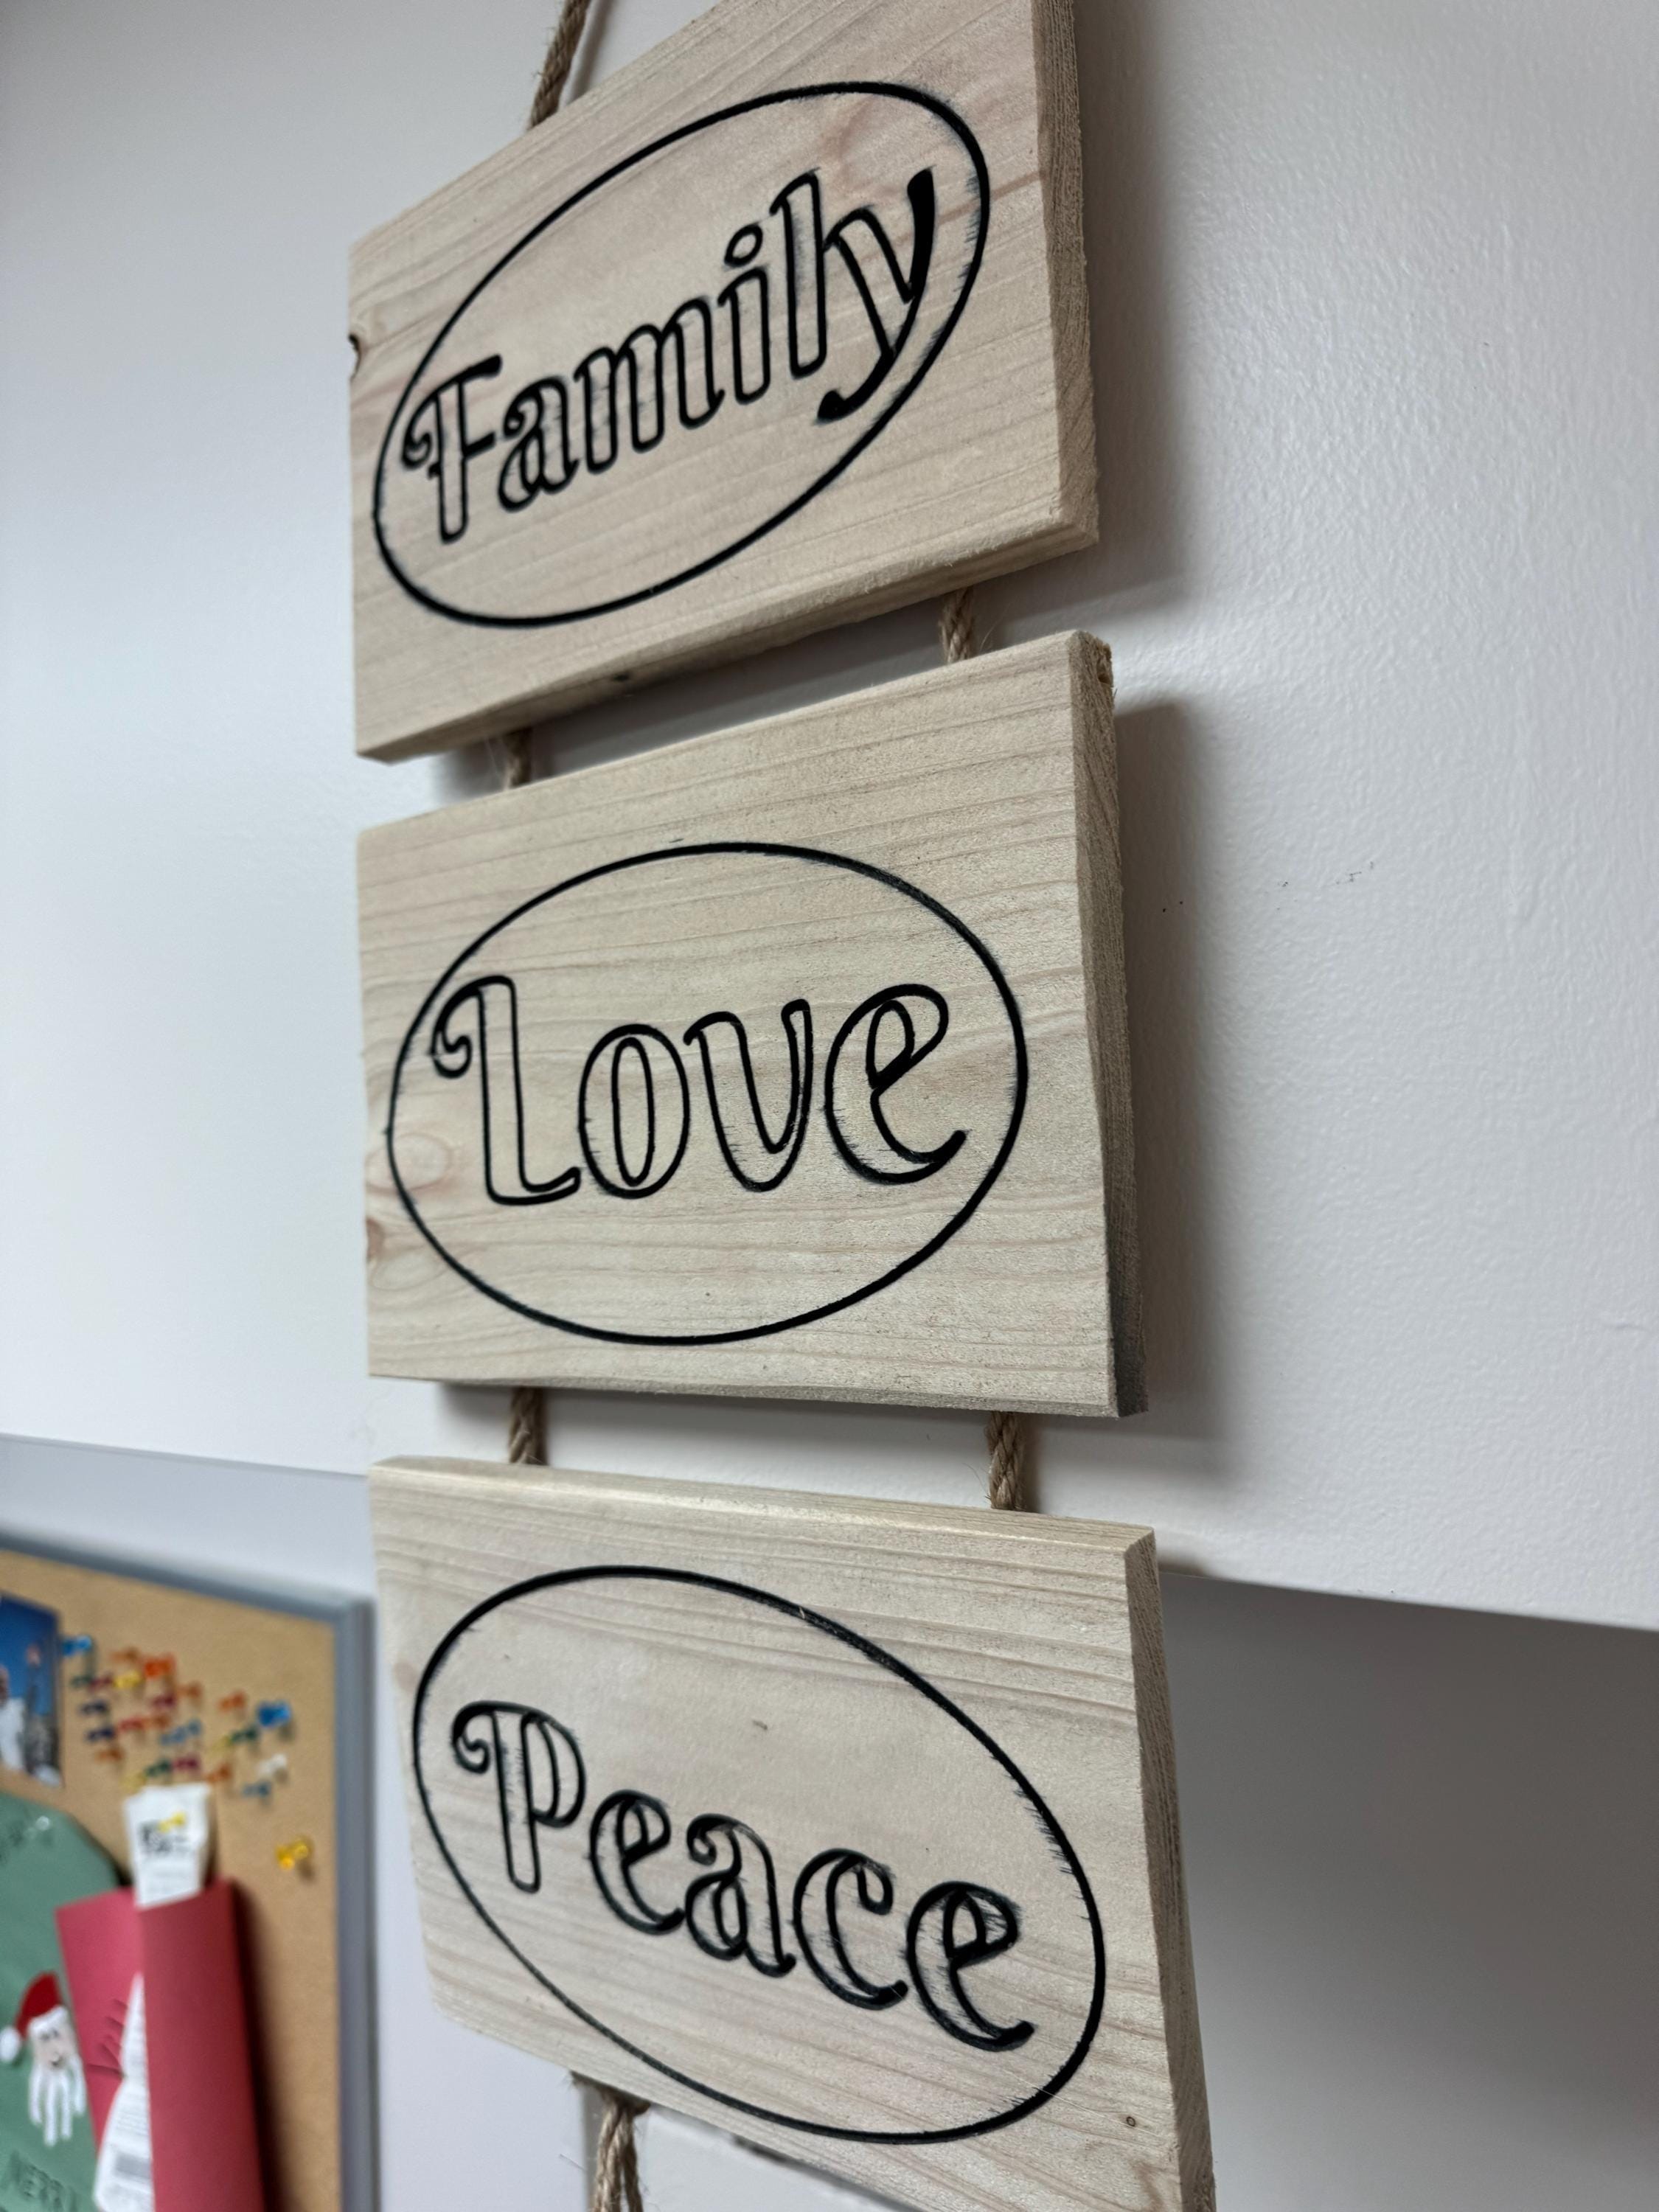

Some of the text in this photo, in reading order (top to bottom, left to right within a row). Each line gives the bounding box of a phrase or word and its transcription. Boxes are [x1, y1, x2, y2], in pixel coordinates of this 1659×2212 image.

[401, 167, 936, 543] Family
[431, 975, 966, 1206] Love
[451, 1700, 1034, 2051] Peace
